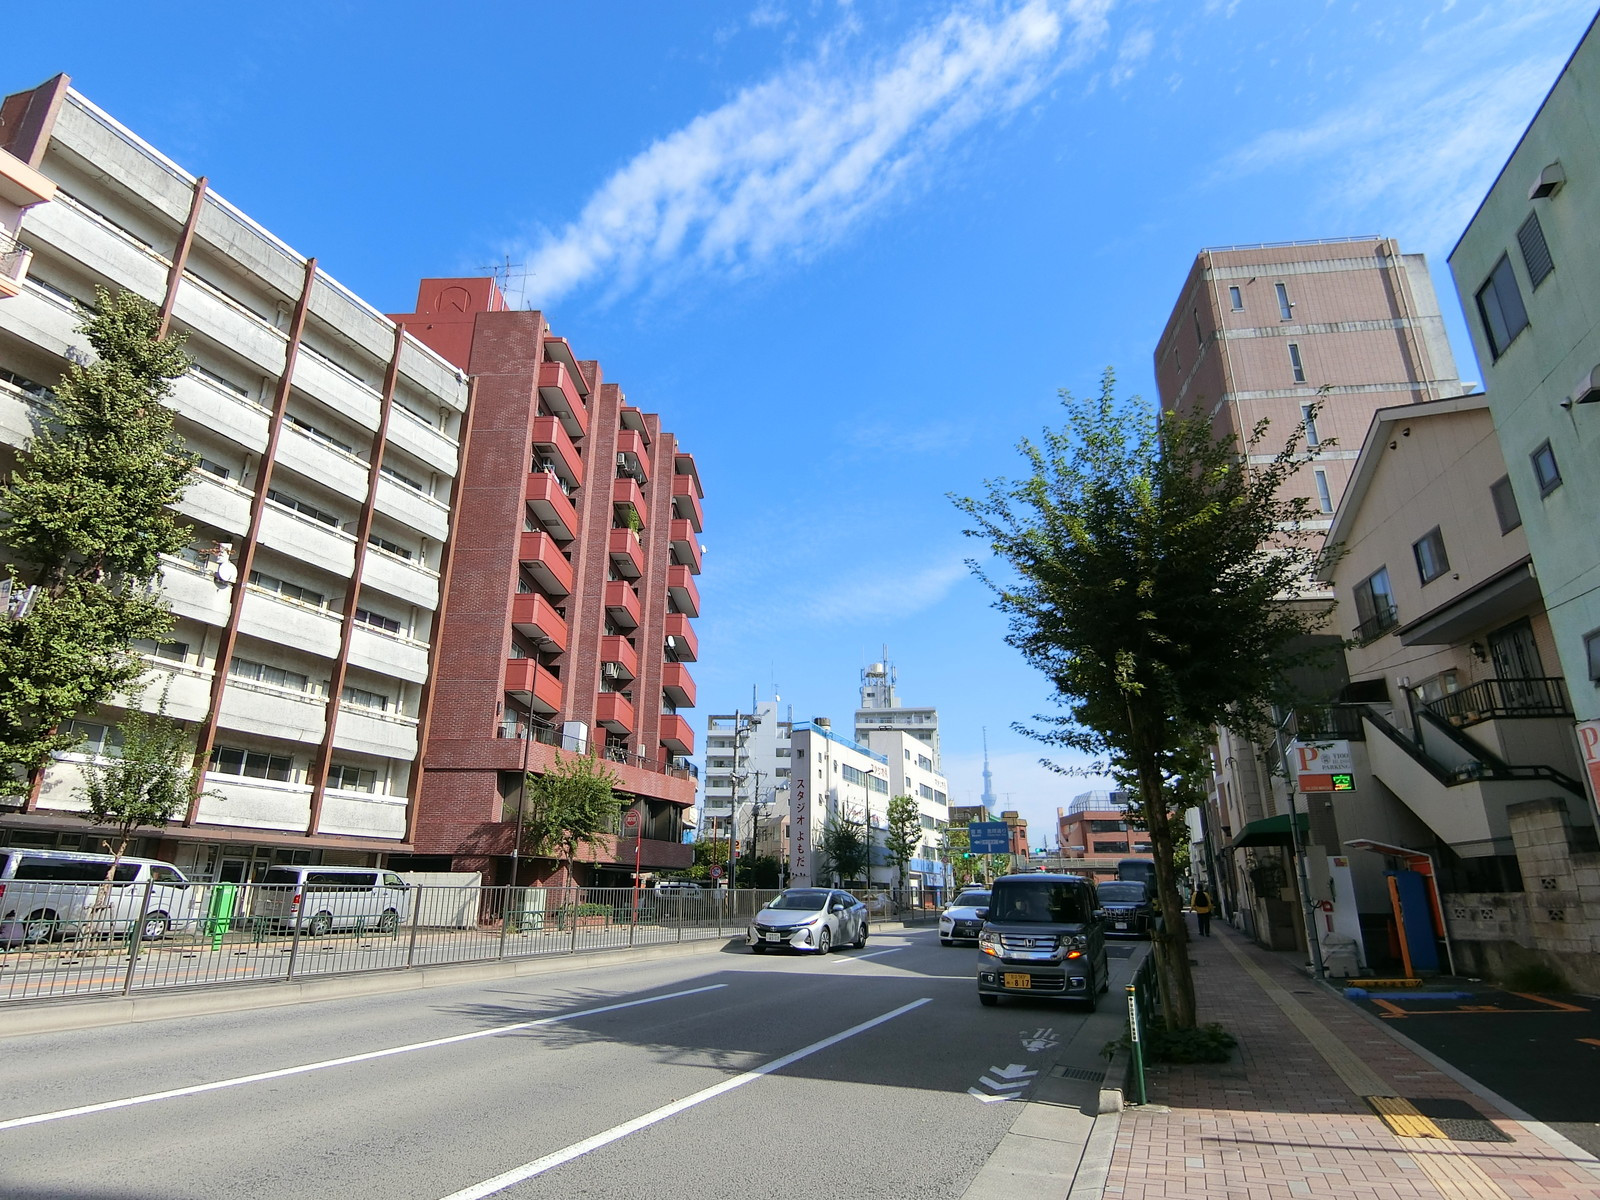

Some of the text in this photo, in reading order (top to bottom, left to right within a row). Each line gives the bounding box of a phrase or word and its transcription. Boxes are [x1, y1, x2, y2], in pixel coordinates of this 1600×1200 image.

[1295, 747, 1318, 771] P
[1579, 727, 1598, 760] P
[796, 779, 805, 867] スタジオ よもだ
